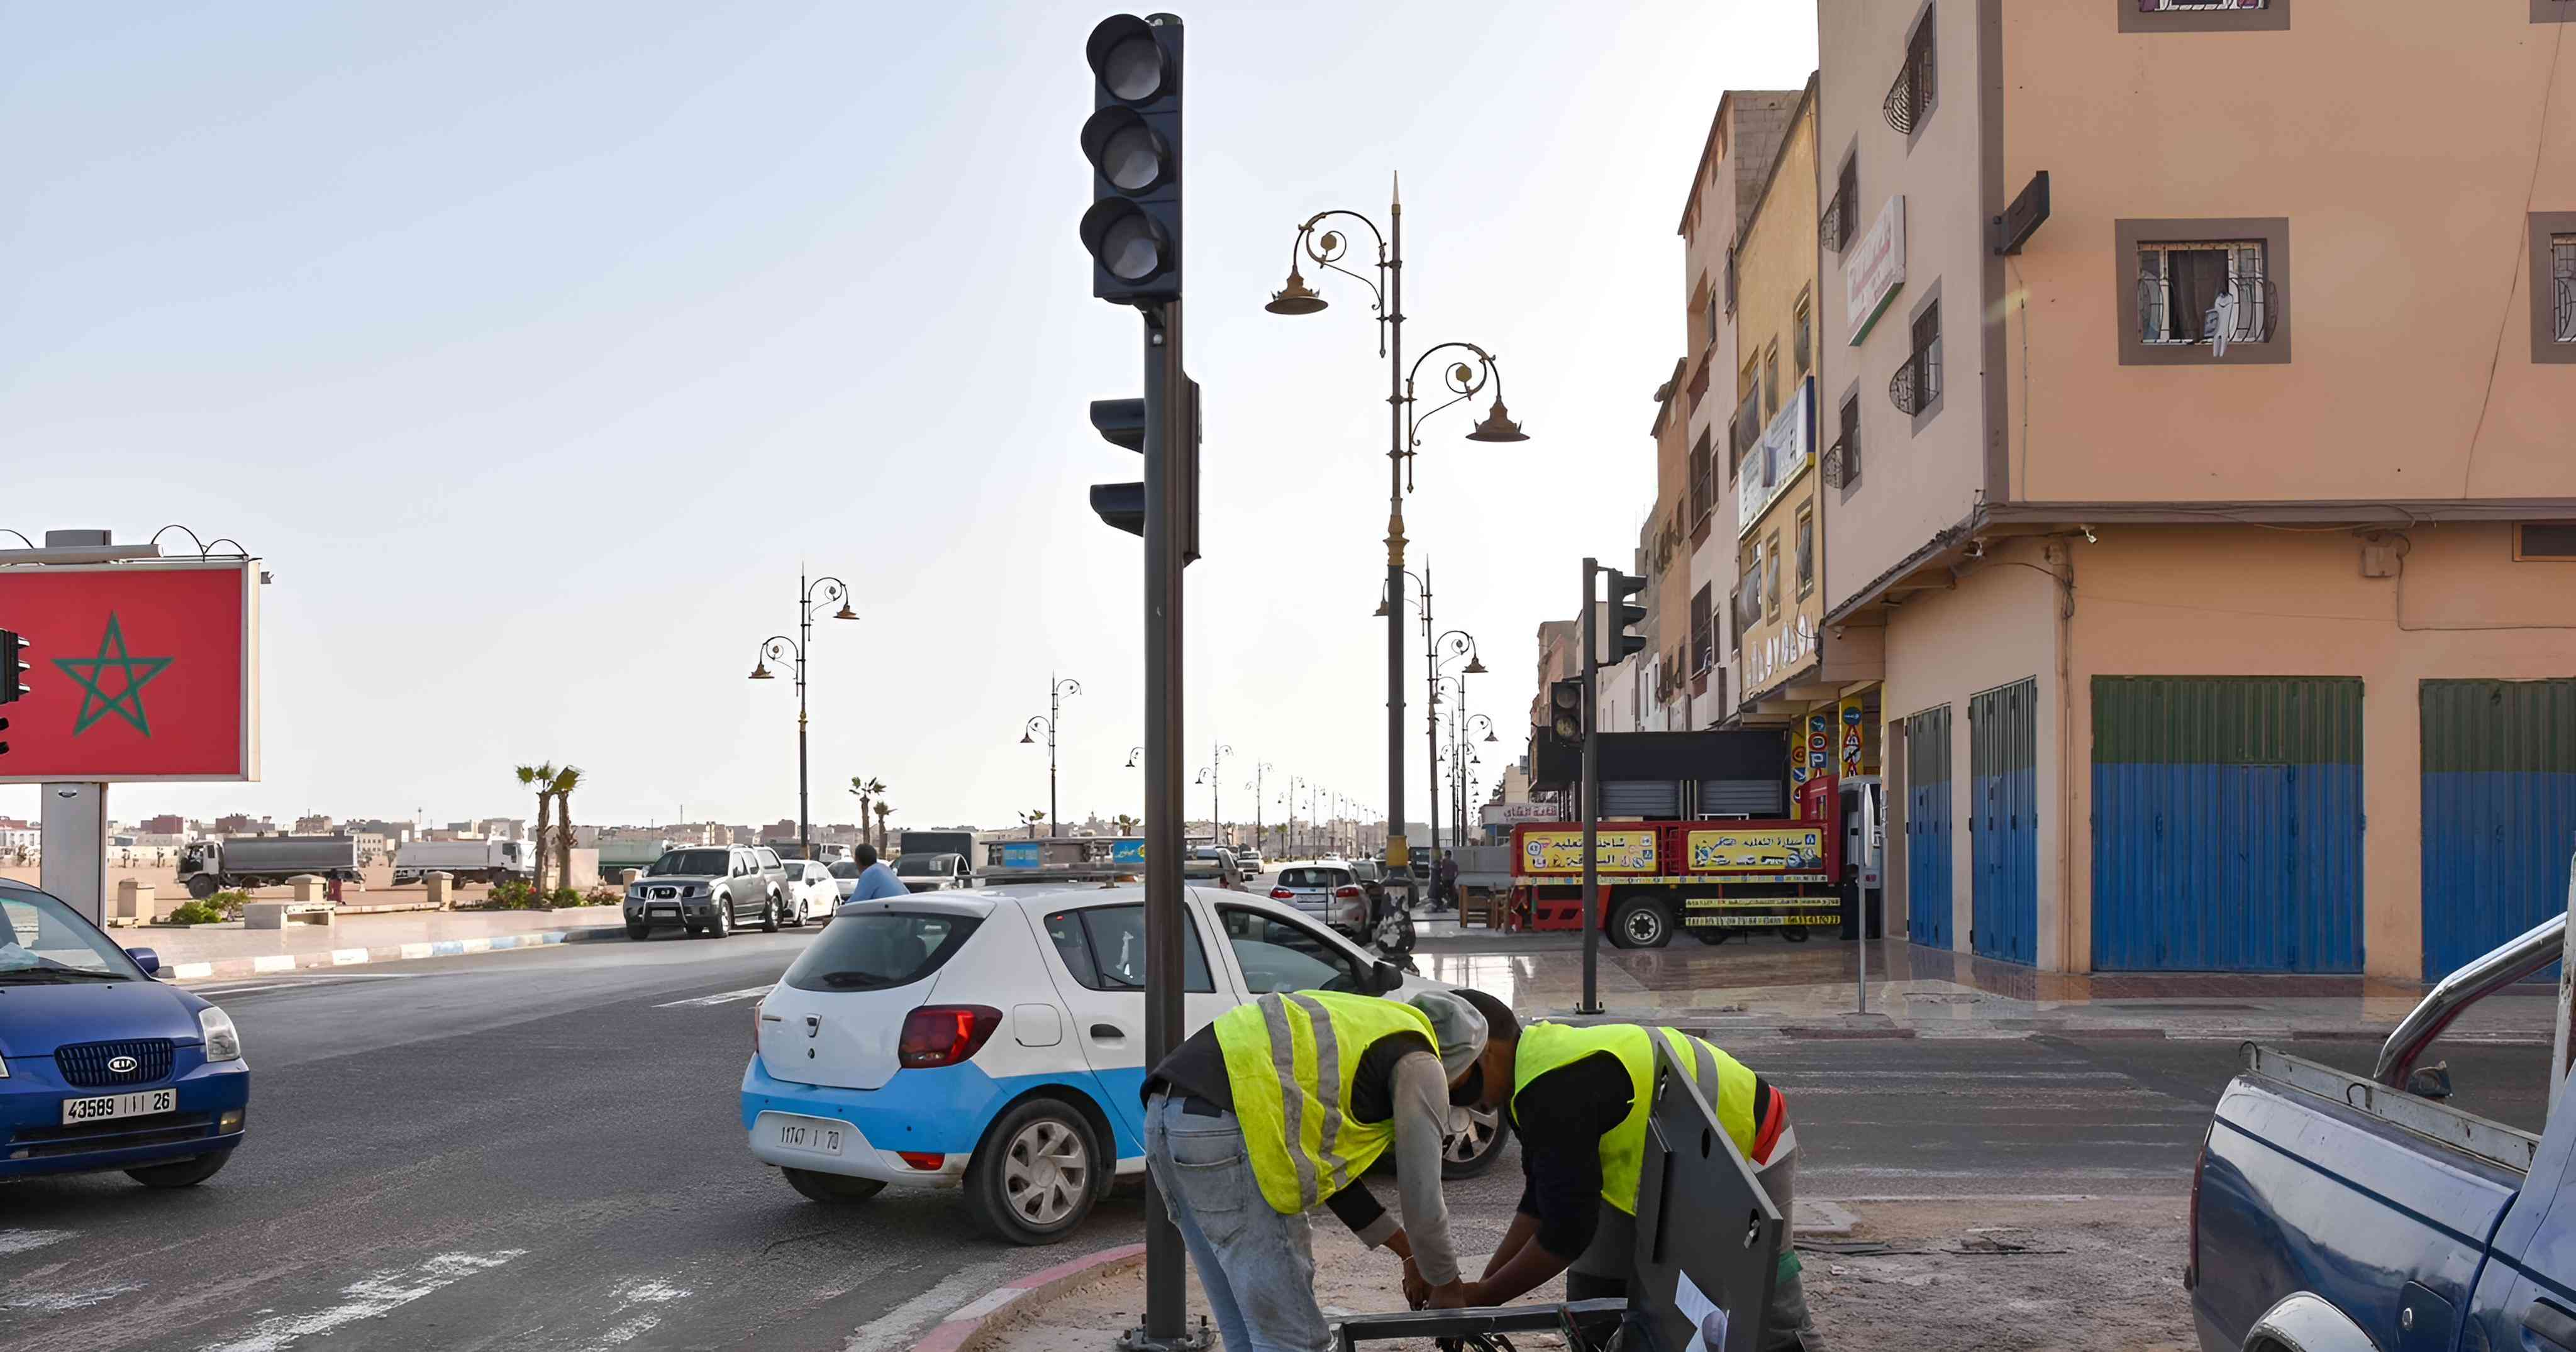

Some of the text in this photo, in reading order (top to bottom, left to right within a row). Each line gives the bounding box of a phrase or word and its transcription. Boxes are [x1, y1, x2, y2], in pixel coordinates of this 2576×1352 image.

[113, 1060, 133, 1068] KIA
[68, 1098, 114, 1119] 43589
[153, 1092, 170, 1111] 26
